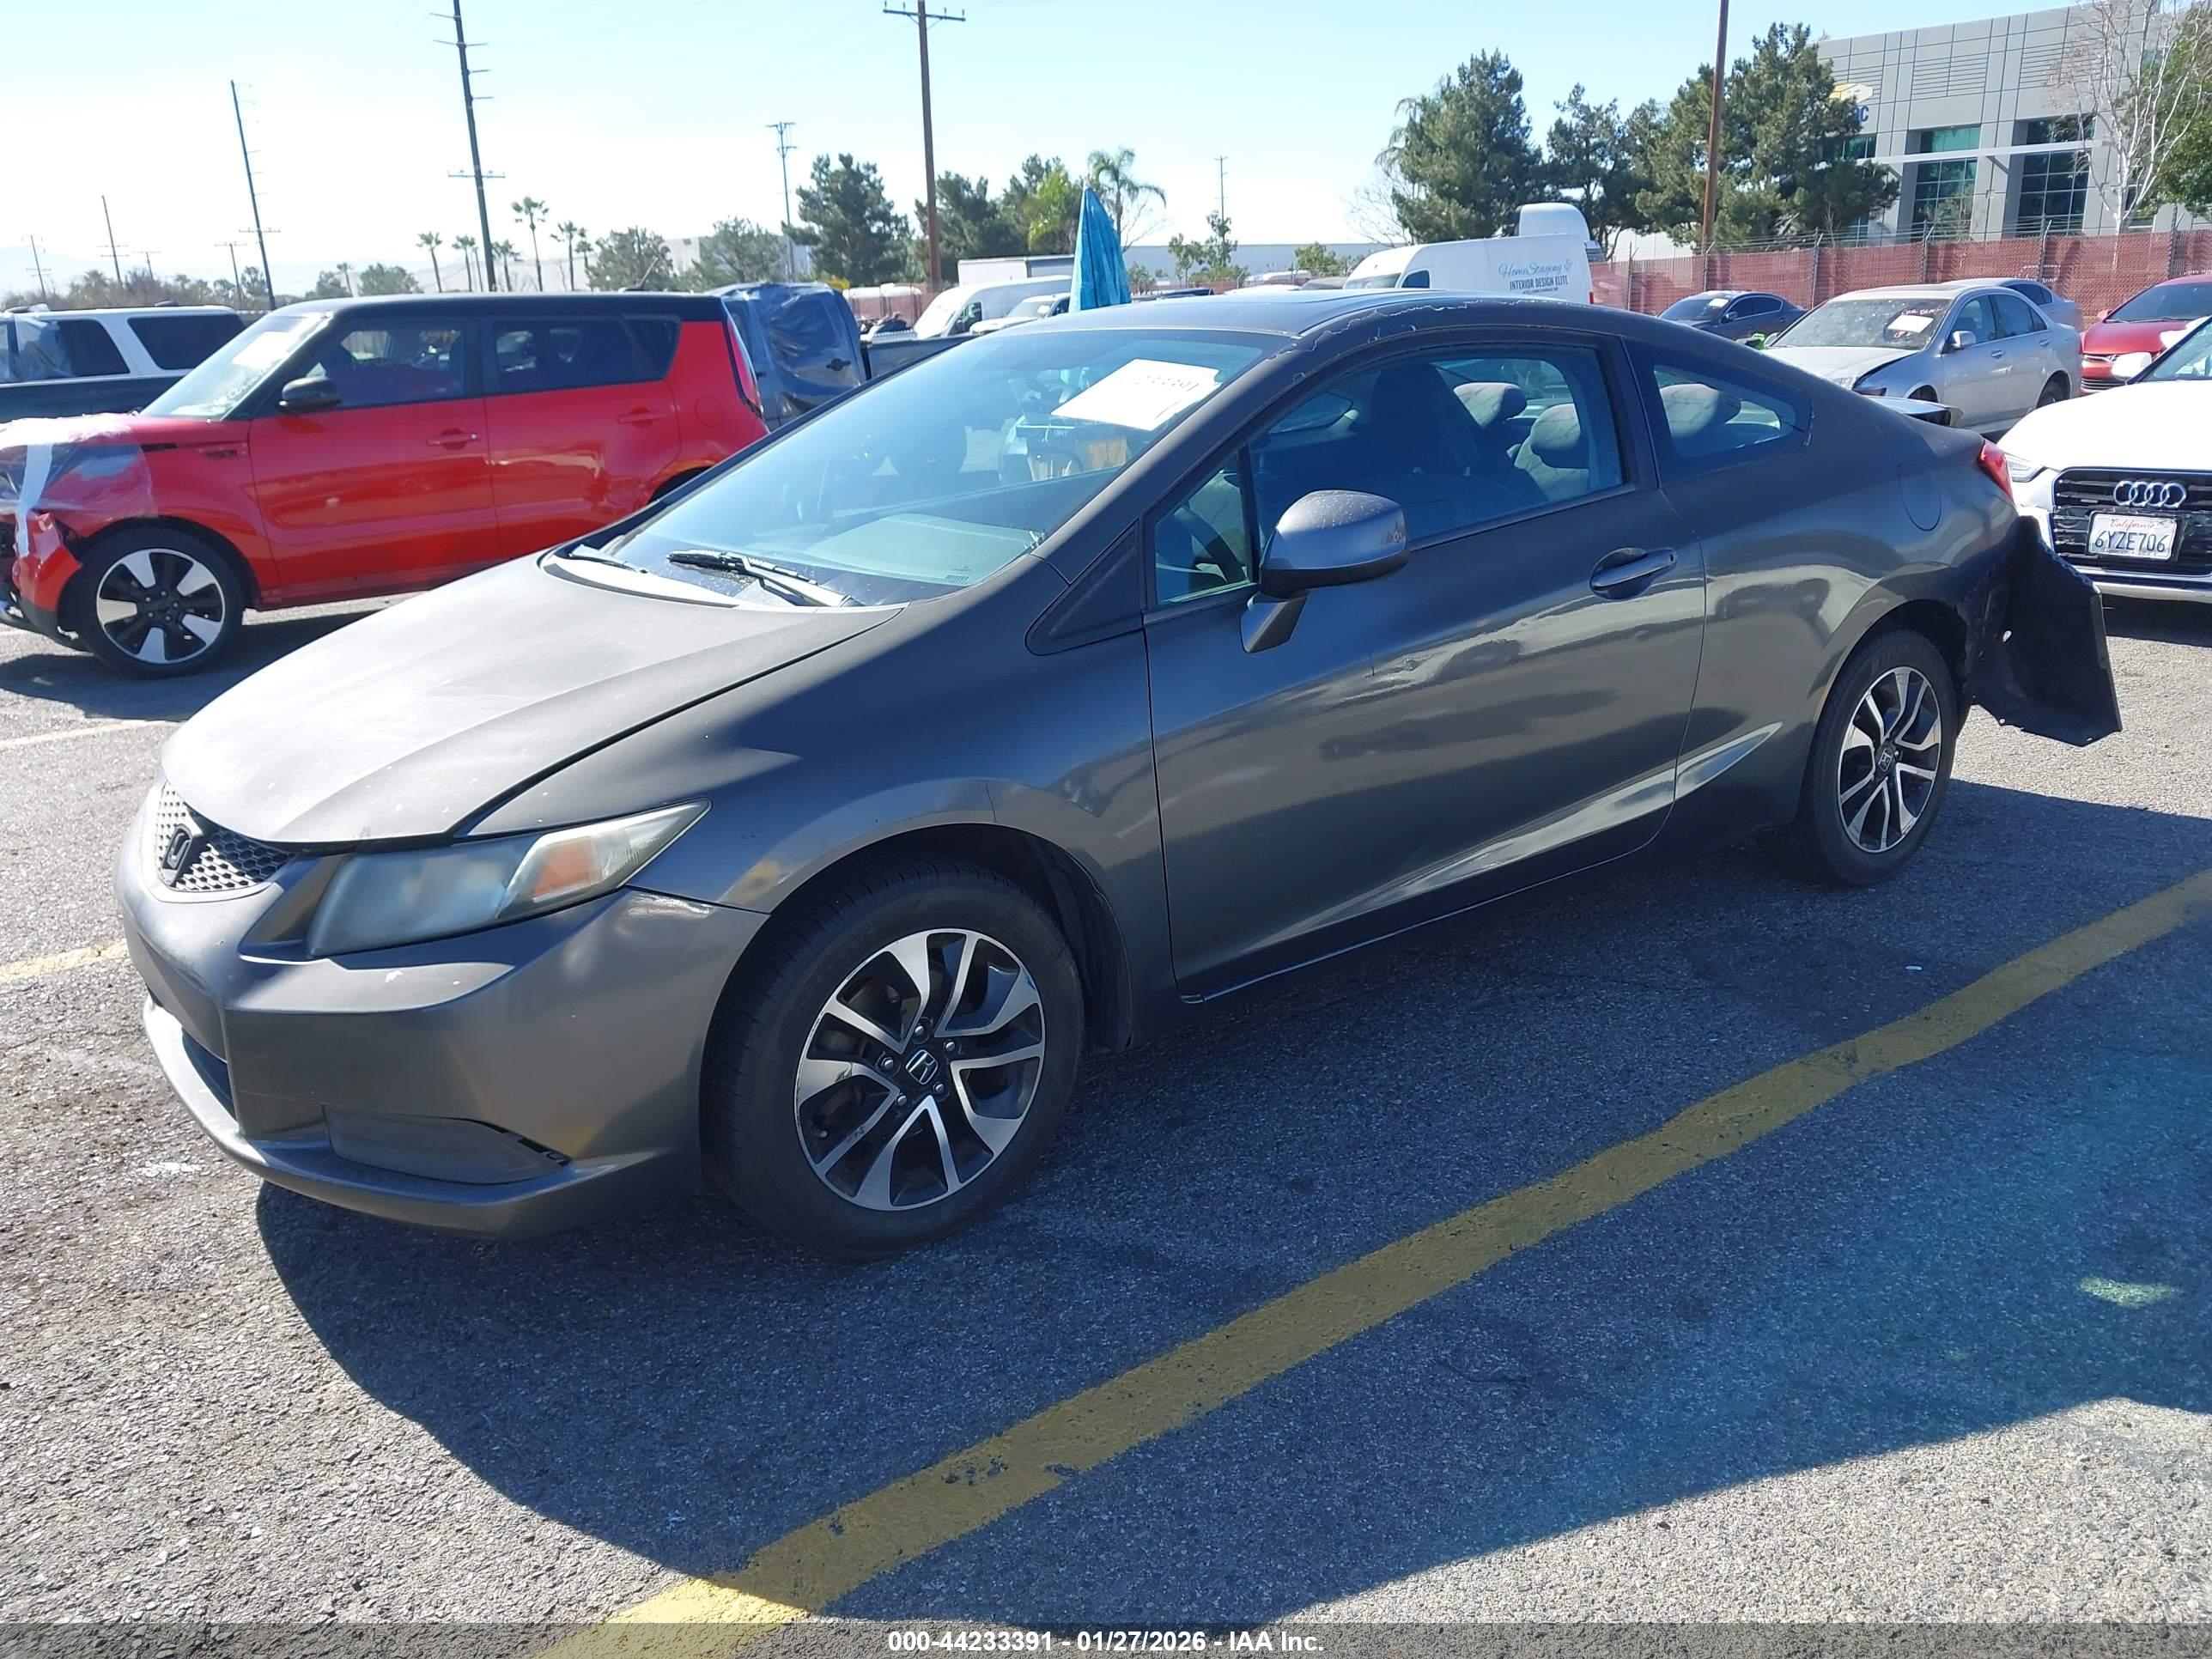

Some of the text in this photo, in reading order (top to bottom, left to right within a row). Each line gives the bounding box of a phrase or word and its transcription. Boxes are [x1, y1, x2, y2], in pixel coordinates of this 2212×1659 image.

[1510, 278, 1534, 290] INTERIOR
[1535, 276, 1554, 288] DESIGN
[1555, 275, 1569, 285] ELITE
[2110, 518, 2156, 532] California
[2094, 531, 2170, 552] 6YZE706
